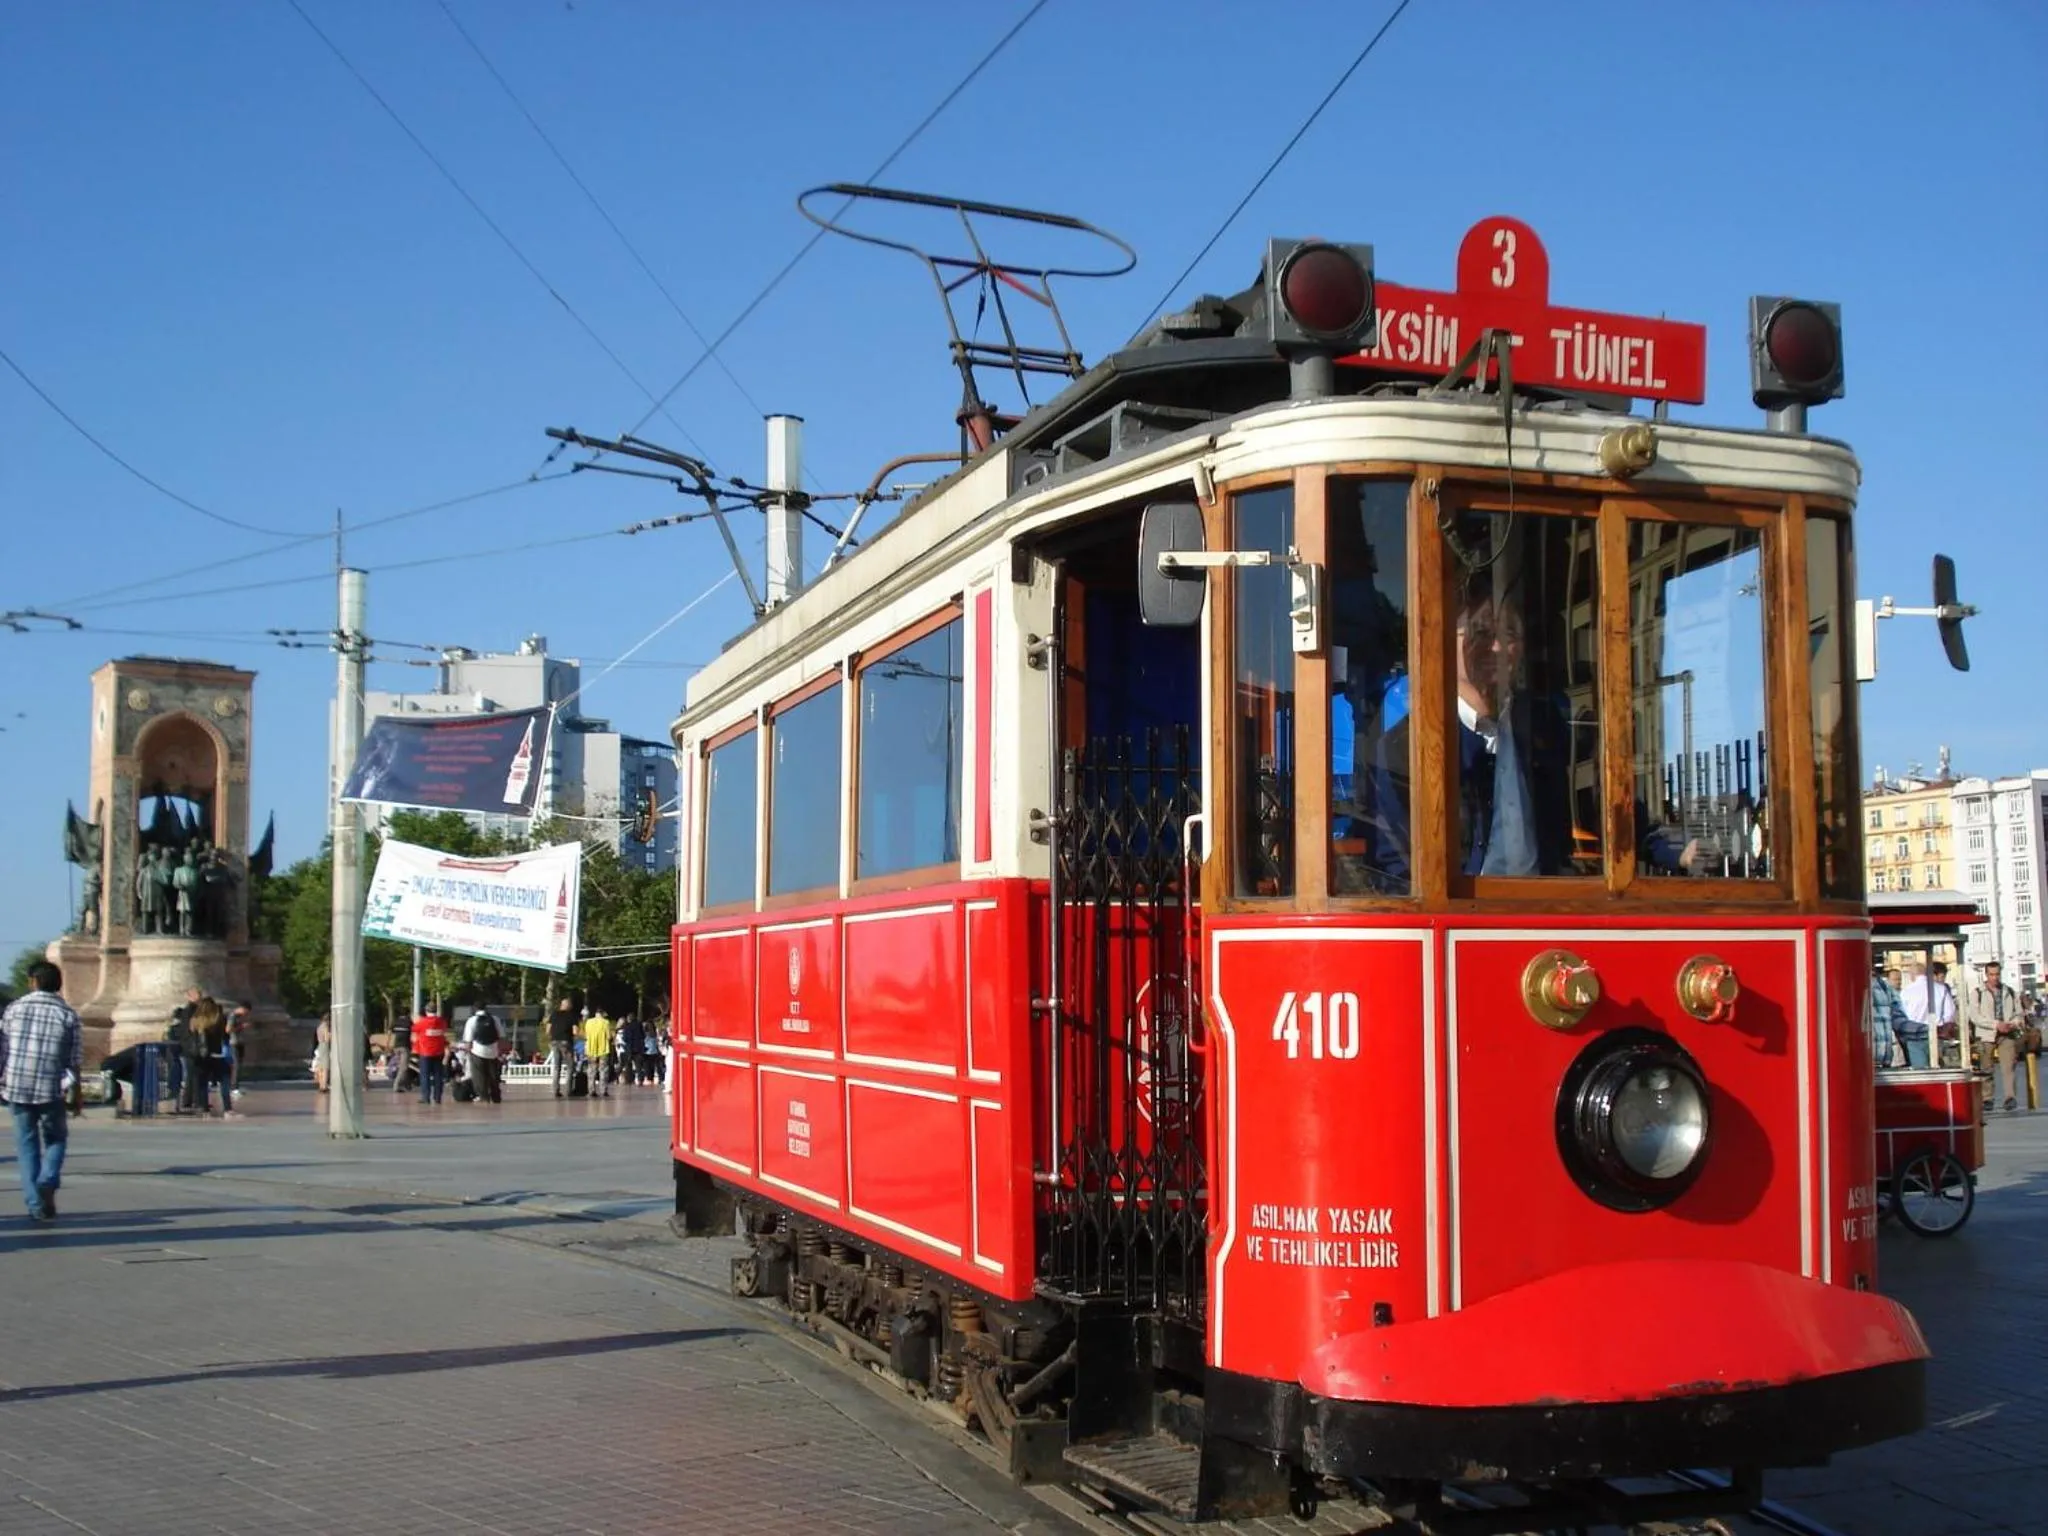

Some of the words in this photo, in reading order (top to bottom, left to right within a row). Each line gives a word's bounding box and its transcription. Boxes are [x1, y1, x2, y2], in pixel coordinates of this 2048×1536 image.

[1491, 228, 1517, 289] 3
[1360, 304, 1459, 367] KSİM
[1550, 322, 1667, 389] TÜNEL
[1272, 991, 1359, 1060] 410
[1251, 1203, 1319, 1234] ASILMAK
[1328, 1207, 1393, 1235] YASAK
[1246, 1235, 1264, 1262] VE
[1269, 1237, 1400, 1269] TEHLİKELİDİR
